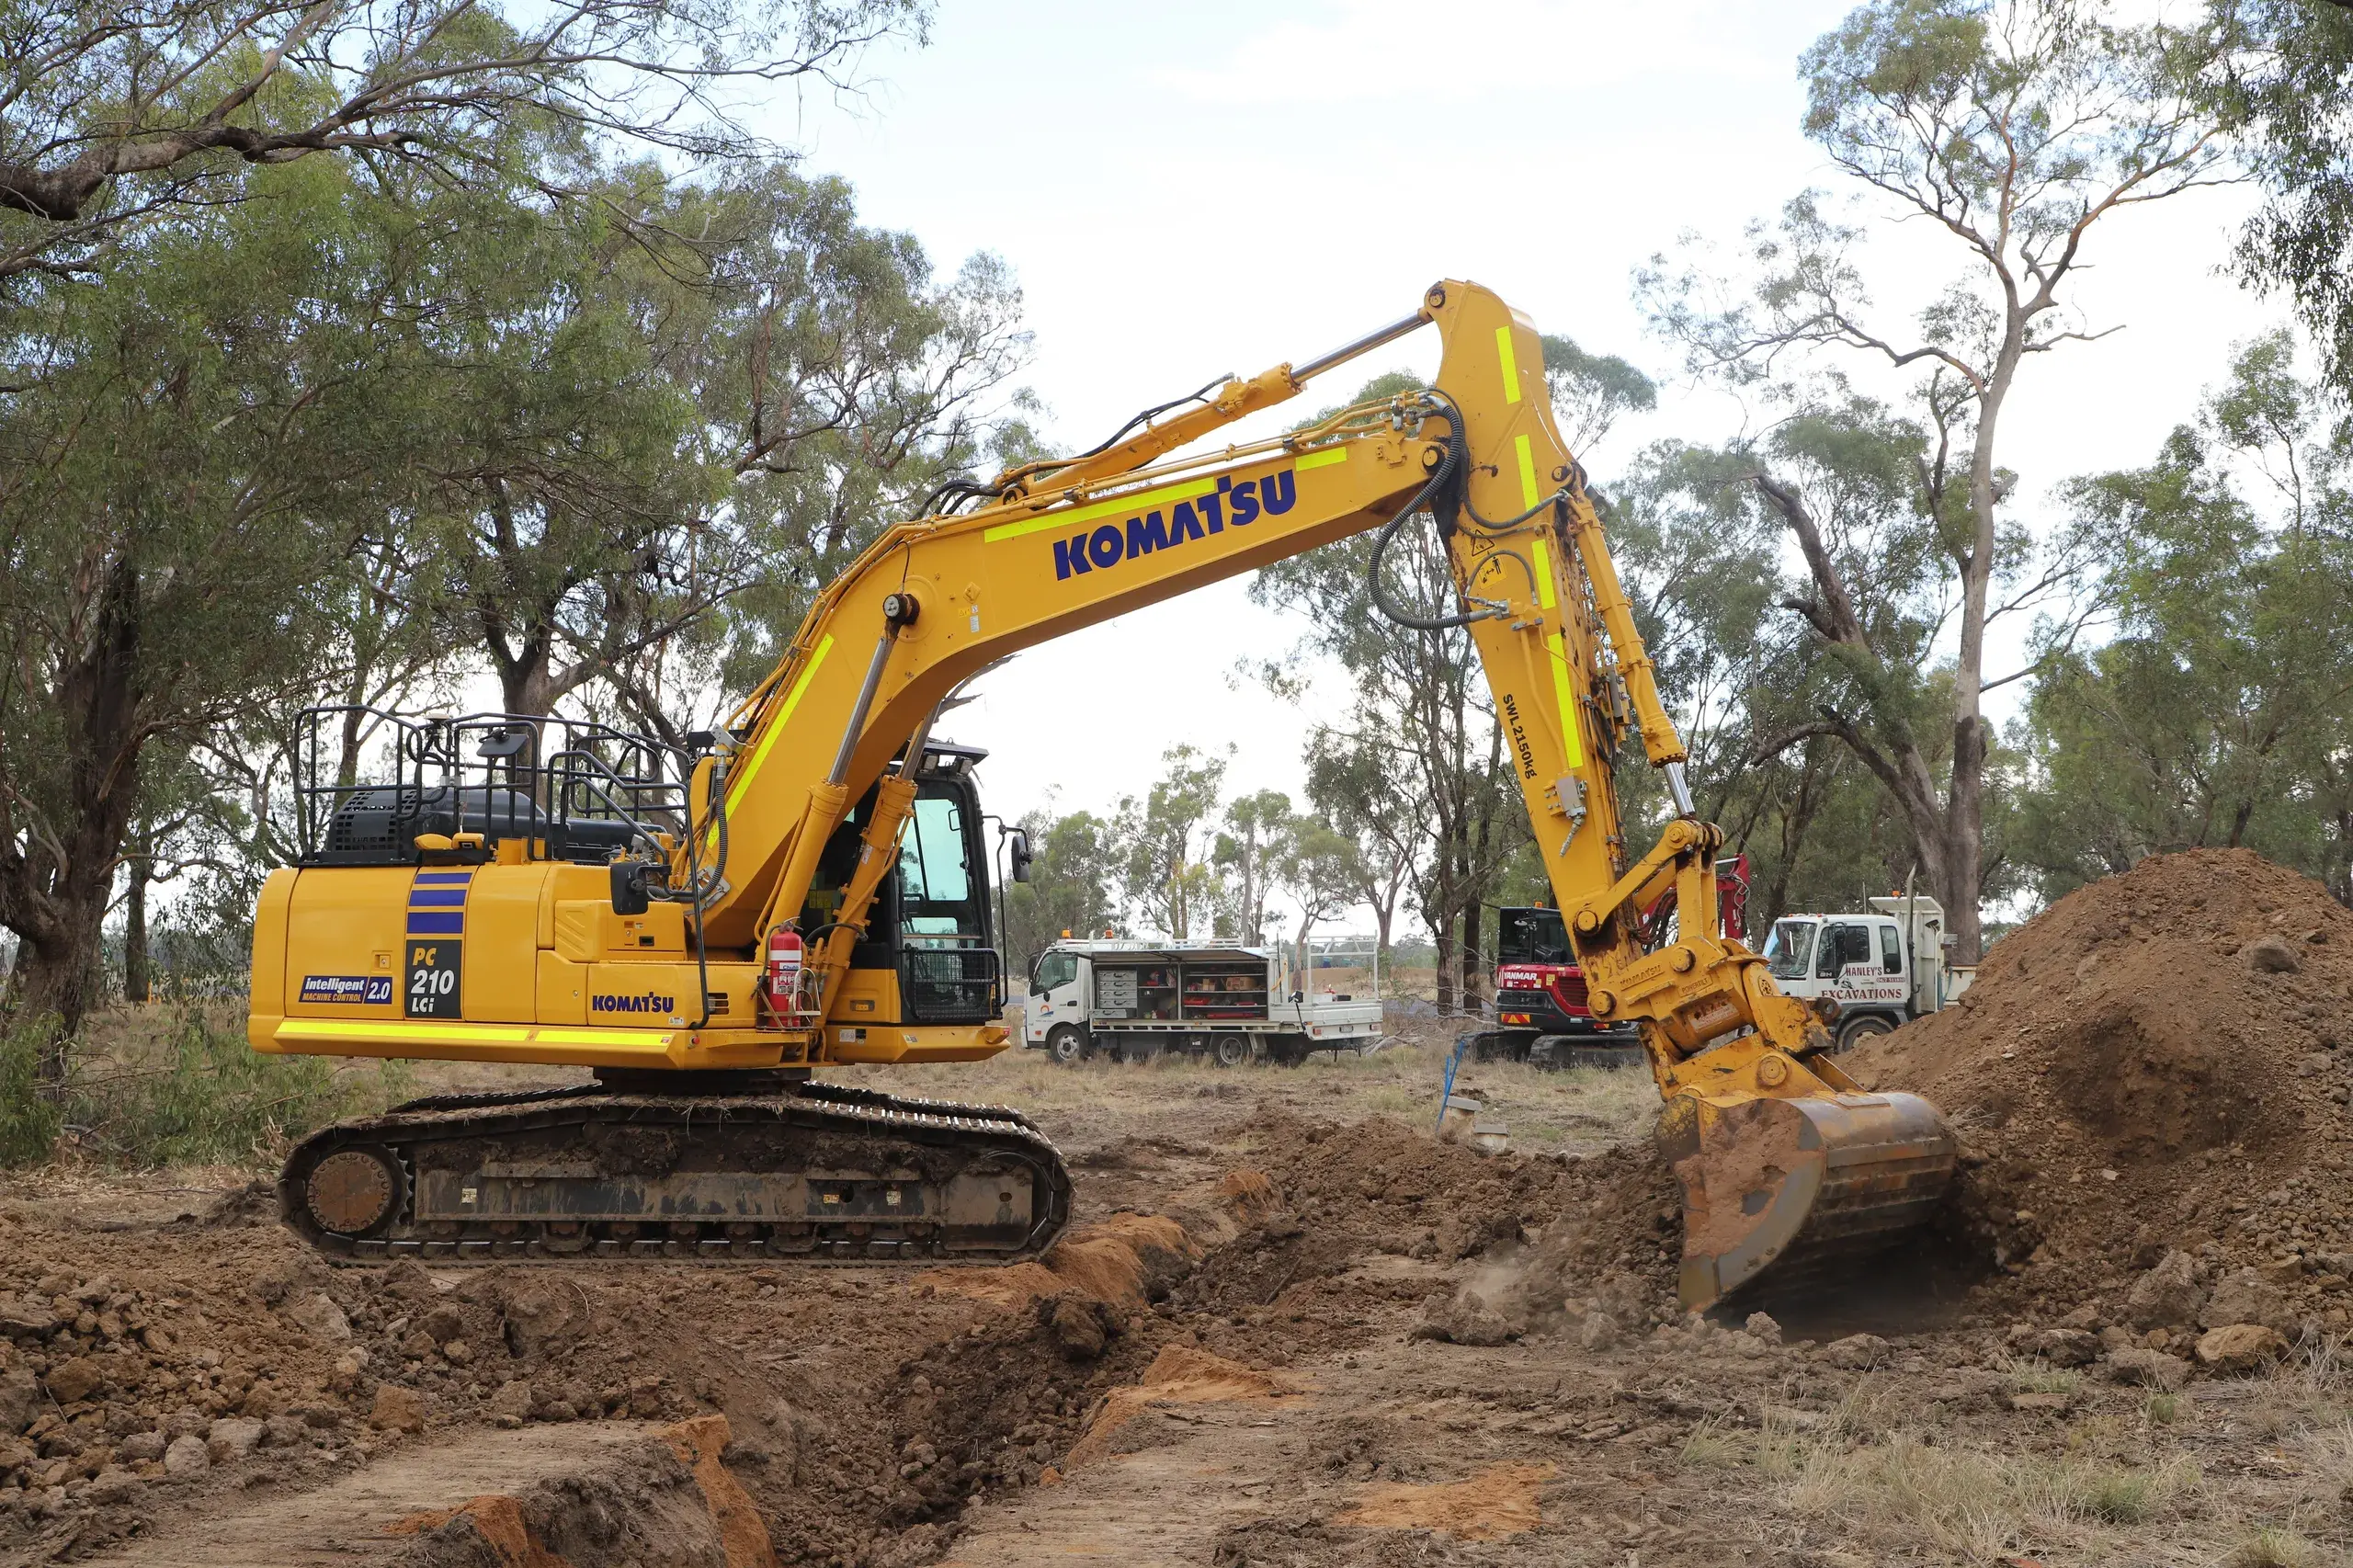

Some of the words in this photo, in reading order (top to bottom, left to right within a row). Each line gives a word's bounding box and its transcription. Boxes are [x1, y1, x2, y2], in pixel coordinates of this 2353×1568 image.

[1053, 469, 1297, 581] KOMATSU
[1503, 693, 1519, 726] SWL
[1512, 725, 1537, 779] 2150kg
[413, 947, 437, 966] PC
[1504, 971, 1538, 981] YANMAR
[1846, 966, 1882, 976] HANLEY'S
[305, 977, 365, 994] intelligent
[368, 982, 391, 999] 2.0
[410, 970, 455, 995] 210
[302, 993, 332, 1002] MACHINE
[333, 994, 361, 1002] CONTROL
[592, 992, 674, 1013] KOMATSU
[1821, 988, 1903, 1000] EXCAVATIONS
[412, 997, 434, 1012] LCi
